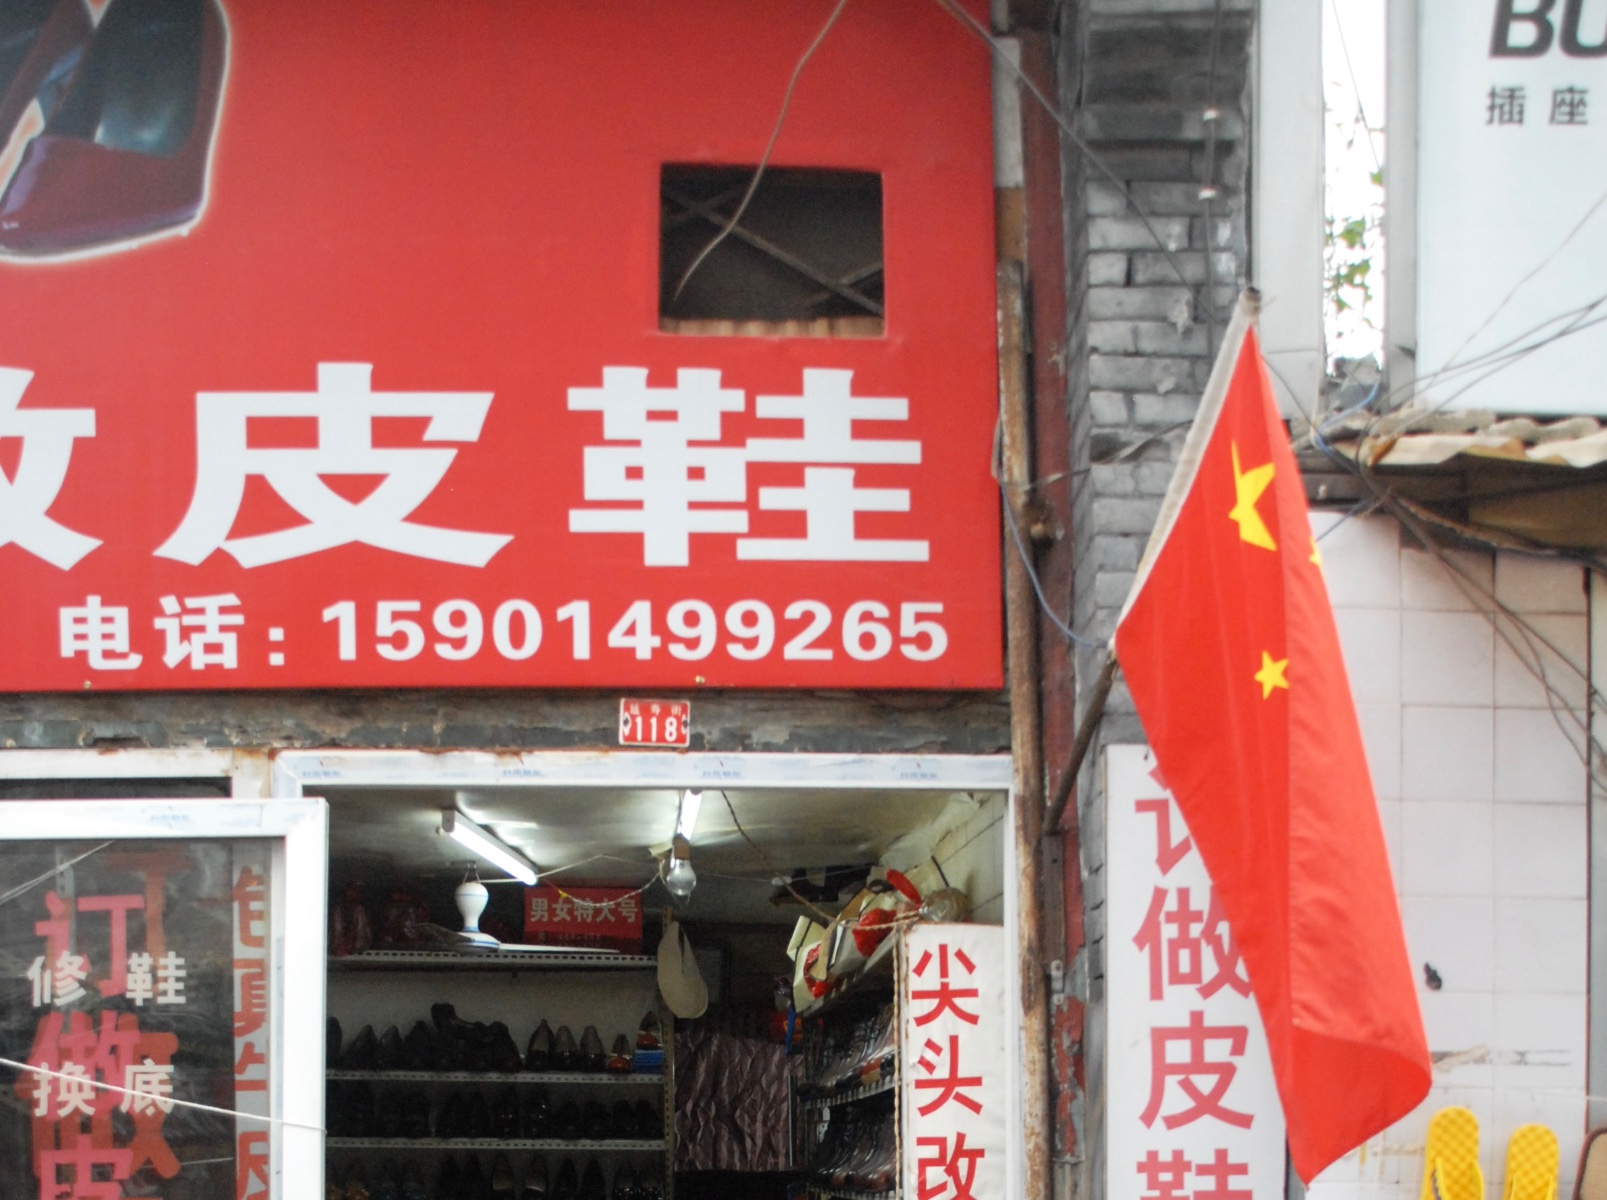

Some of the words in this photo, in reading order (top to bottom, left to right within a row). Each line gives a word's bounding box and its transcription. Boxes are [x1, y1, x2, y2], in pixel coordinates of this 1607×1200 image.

[1486, 84, 1589, 126] 插座
[635, 716, 677, 742] 118
[530, 898, 638, 922] 男女特大号
[27, 951, 187, 1007] 修鞋
[33, 1058, 175, 1117] 换底
